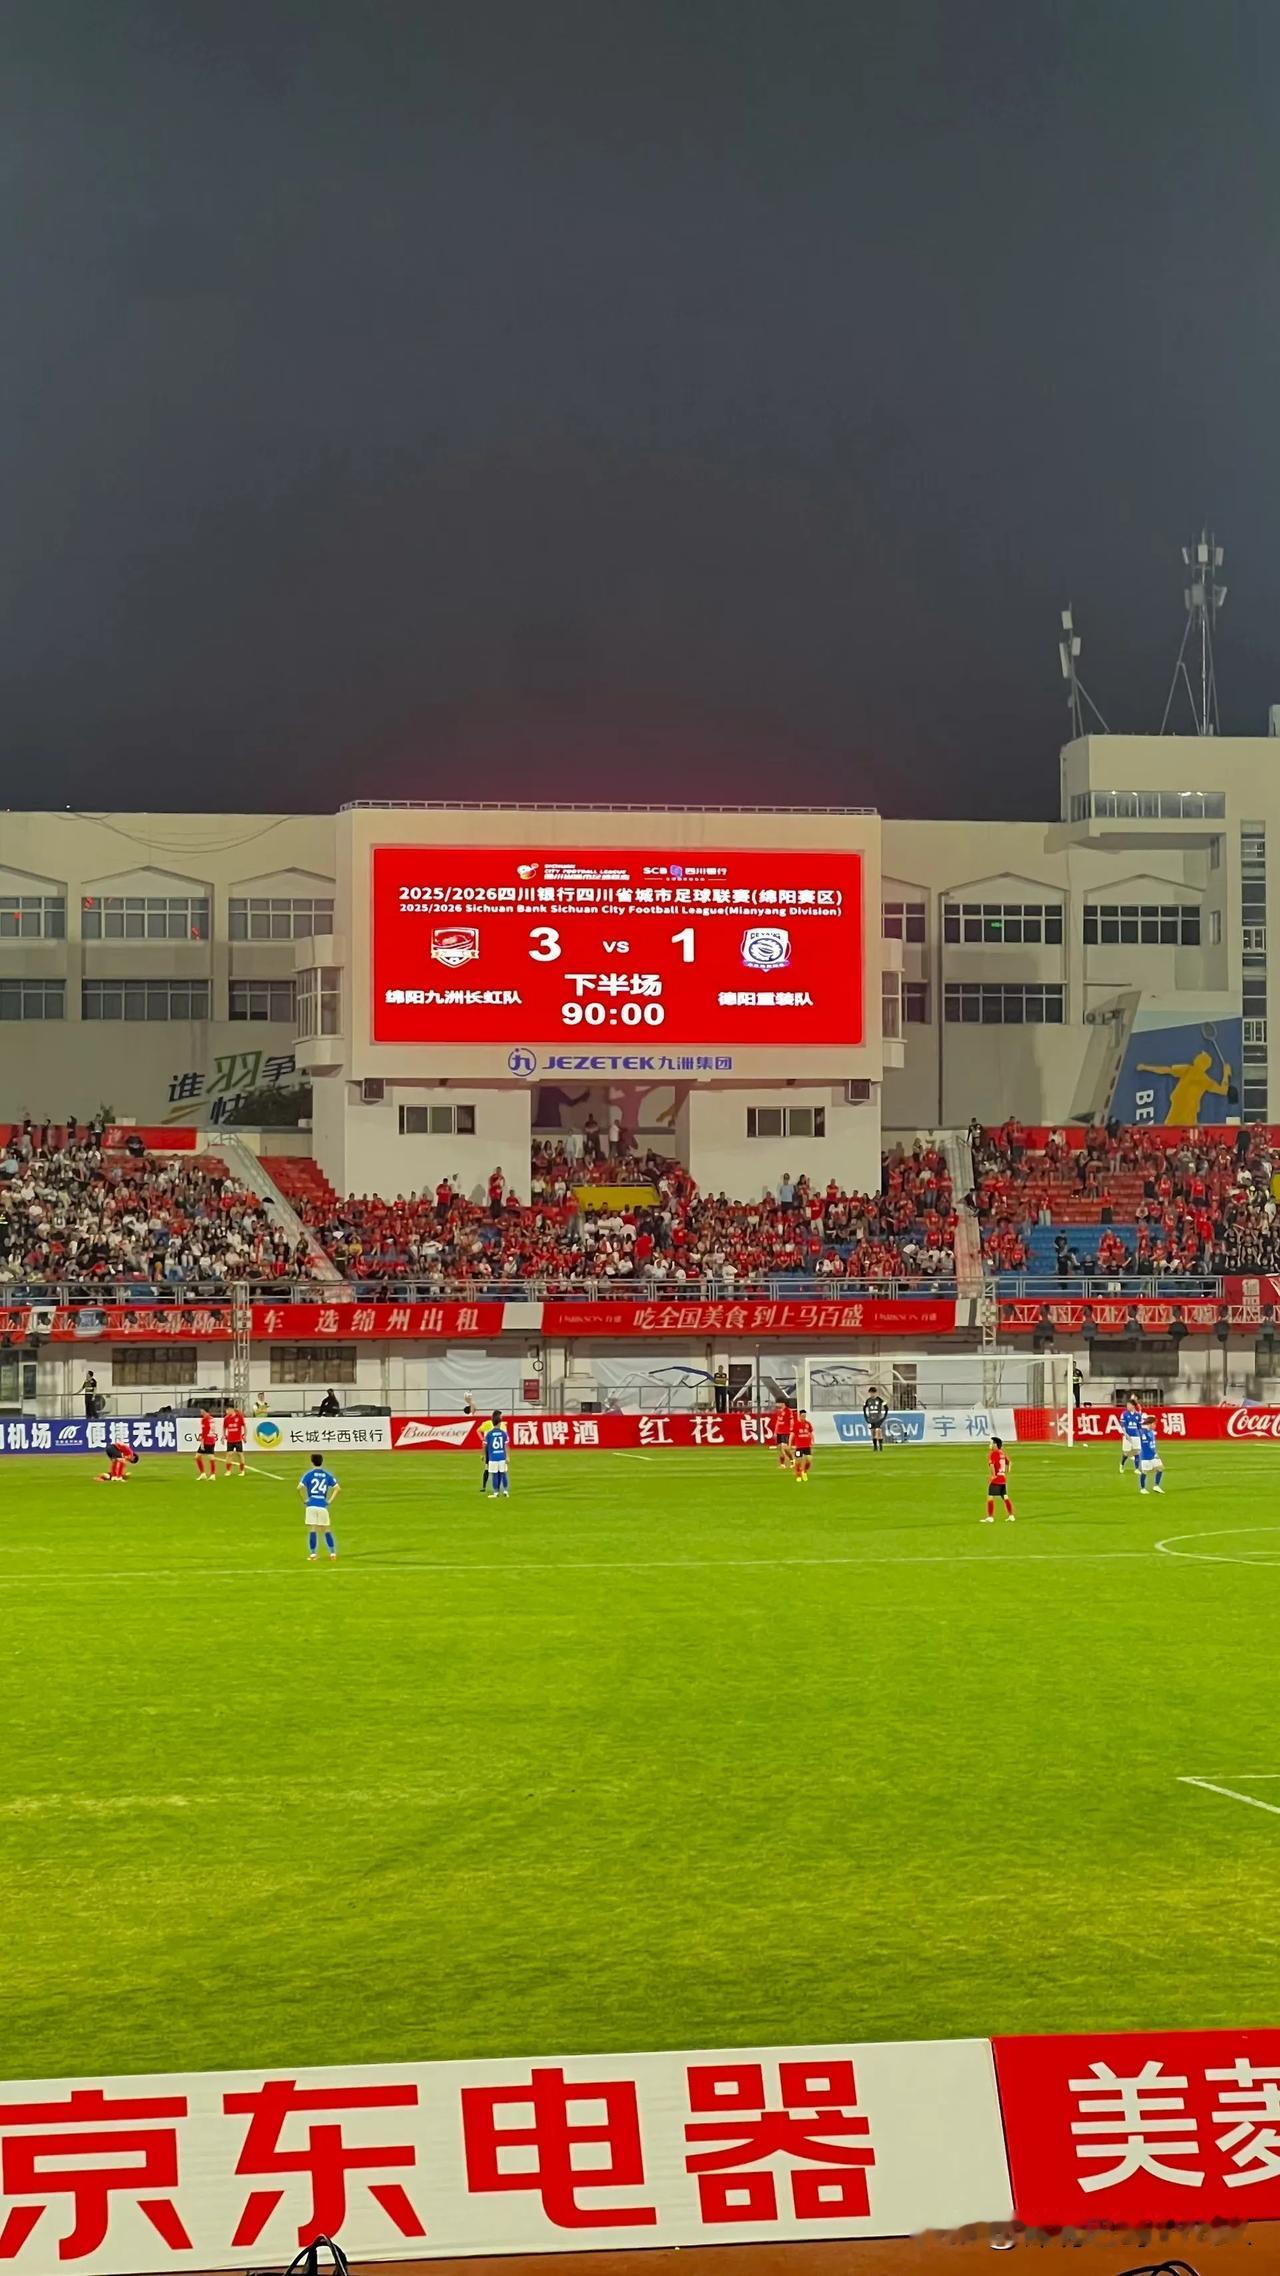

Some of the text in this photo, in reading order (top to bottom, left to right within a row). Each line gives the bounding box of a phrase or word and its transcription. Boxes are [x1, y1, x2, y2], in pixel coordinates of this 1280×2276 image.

[400, 904, 462, 913] 2025/2026
[465, 904, 514, 913] Sichuan
[517, 905, 547, 913] Bank
[551, 905, 600, 914] Sichuan
[602, 905, 625, 915] City
[629, 906, 679, 915] Football
[790, 907, 842, 917] Division)
[529, 926, 562, 962] 3
[671, 928, 695, 963] 1
[564, 973, 663, 996] 下半场
[385, 989, 523, 1005] 绵阳九洲长虹队
[718, 992, 814, 1006] 德阳重装队
[561, 1002, 665, 1026] 90:00
[168, 1050, 312, 1103] 谁羽争
[0, 1422, 51, 1449] 机场
[86, 1421, 176, 1448] 便捷无忧
[290, 1429, 384, 1443] 长城华西银行
[402, 1426, 468, 1438] Budweiser
[505, 1420, 599, 1445] 威啤酒
[638, 1415, 774, 1444] 红花郎
[932, 1414, 990, 1437] 宇视
[492, 1436, 504, 1449] 61
[310, 1478, 327, 1495] 24
[0, 2060, 877, 2261] 京东电器
